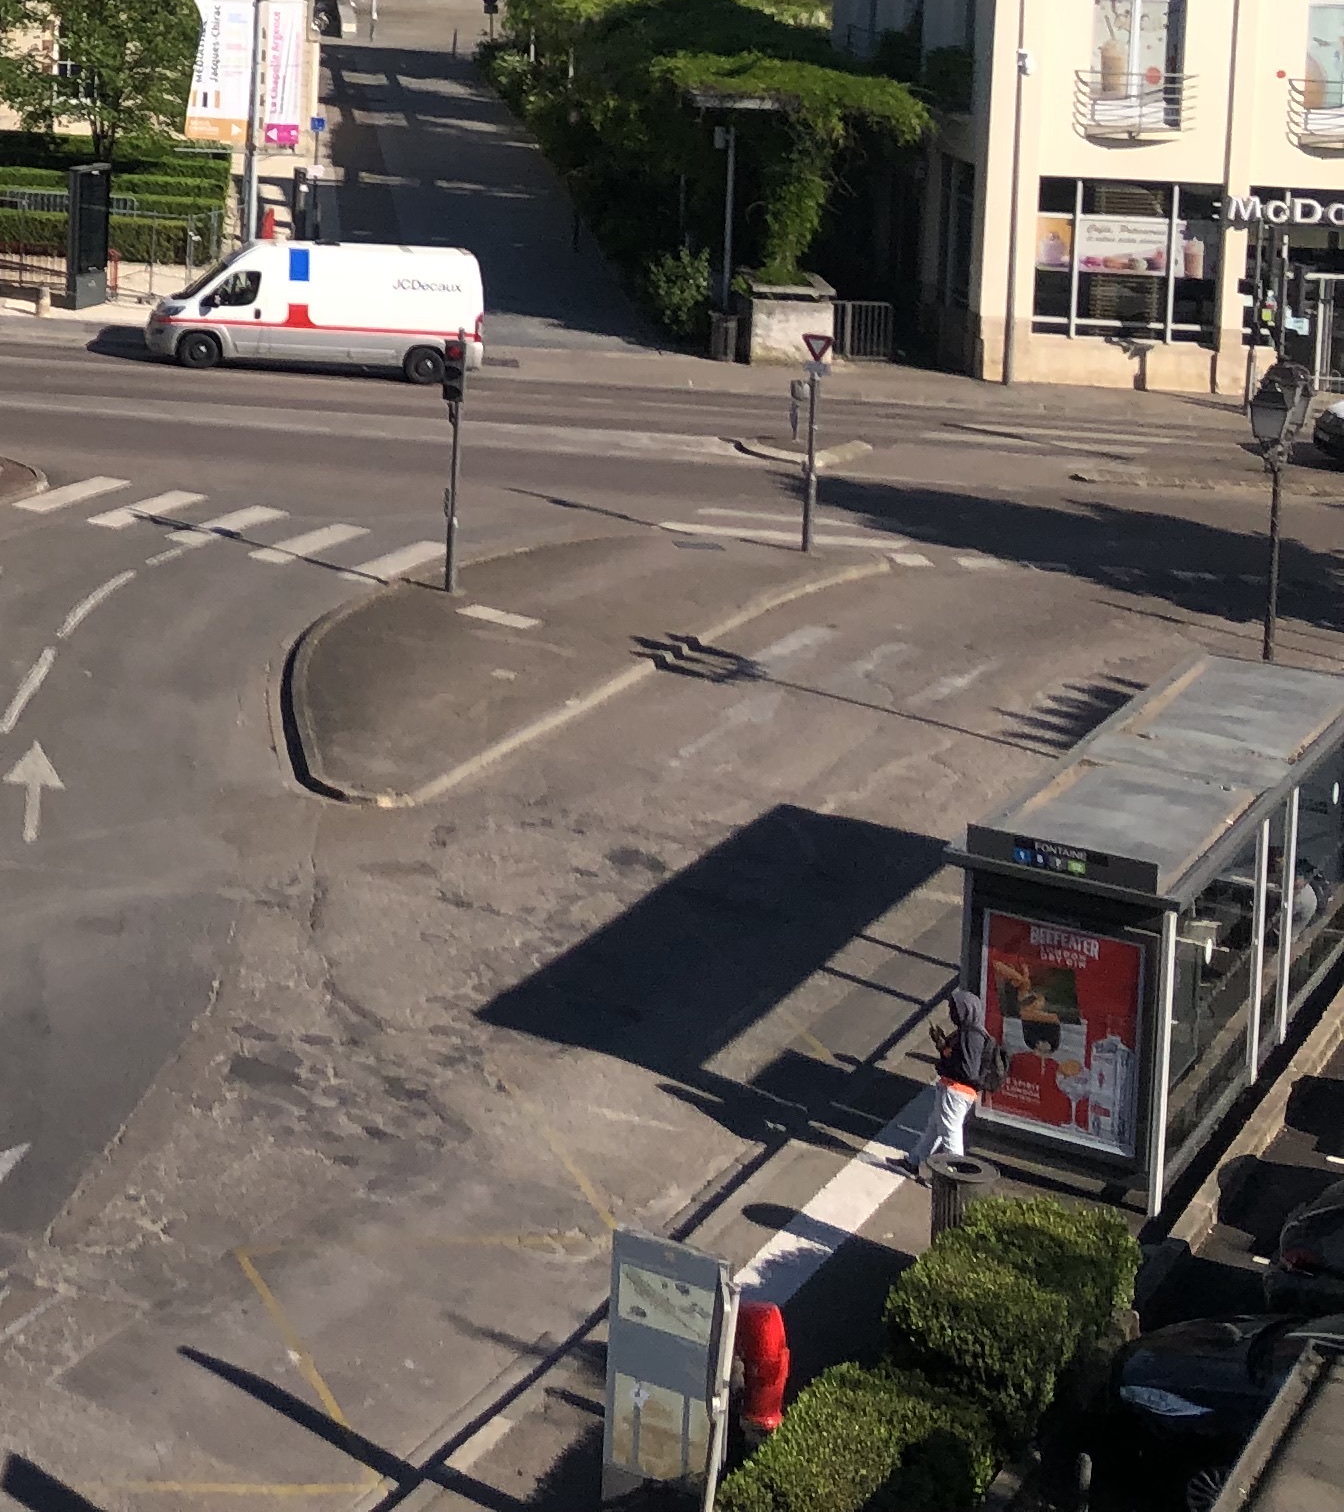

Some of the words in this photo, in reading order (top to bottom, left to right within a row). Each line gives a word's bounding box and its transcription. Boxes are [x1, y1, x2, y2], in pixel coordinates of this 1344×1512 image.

[392, 278, 462, 292] JCDecaux
[1034, 841, 1087, 861] FONTAINE
[1030, 926, 1099, 961] BEEFEATER
